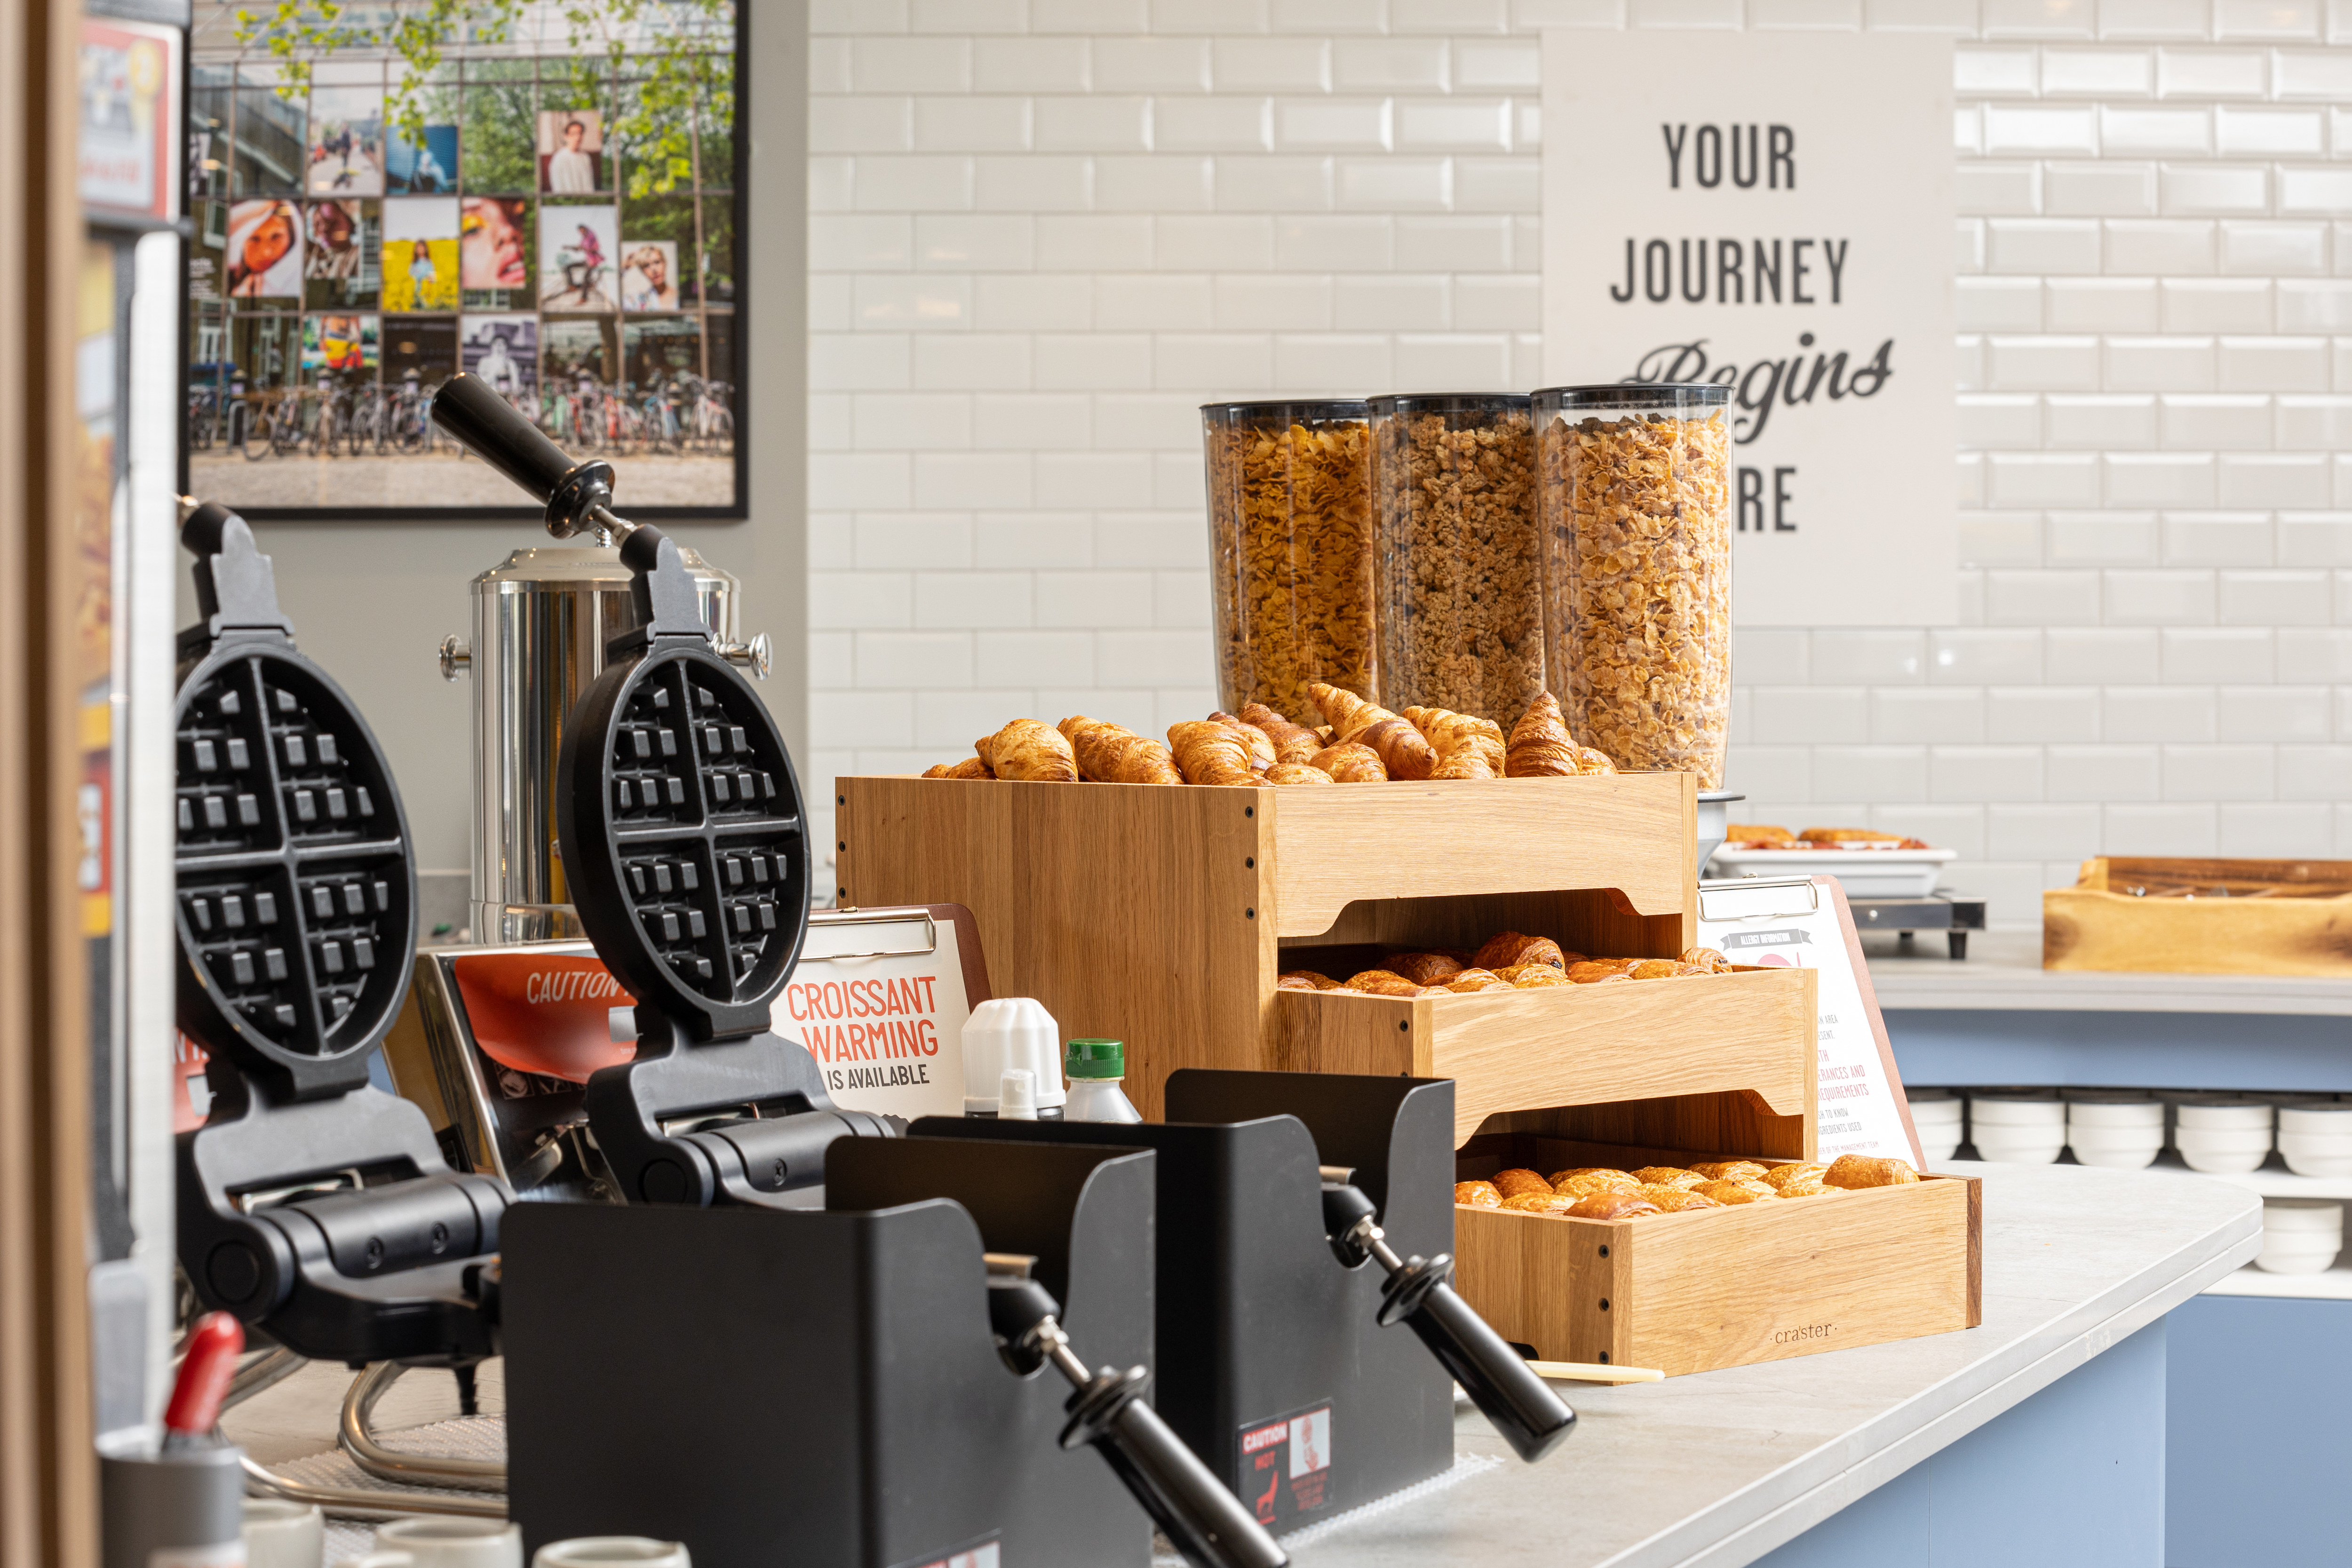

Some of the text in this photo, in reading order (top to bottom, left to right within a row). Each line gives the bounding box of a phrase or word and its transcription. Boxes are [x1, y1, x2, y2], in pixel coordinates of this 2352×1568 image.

[1662, 123, 1797, 190] YOUR
[1610, 238, 1849, 304] JOURNEY
[1737, 466, 1798, 532] RE
[1740, 932, 1791, 945] ALLERGY INFORMATION
[787, 976, 936, 1021] CROISSANT
[1825, 1014, 1838, 1024] AREA
[801, 1019, 939, 1064] WARMING
[1818, 1030, 1835, 1041] ESENT.
[828, 1064, 930, 1090] IS AVAILABLE
[1818, 1065, 1866, 1082] ERANCES AND
[1825, 1109, 1833, 1119] TO
[1833, 1107, 1849, 1118] KNOW
[1847, 1122, 1862, 1131] USED
[1840, 1142, 1867, 1152] MANAGEMENT
[1243, 1425, 1287, 1451] CAUTION
